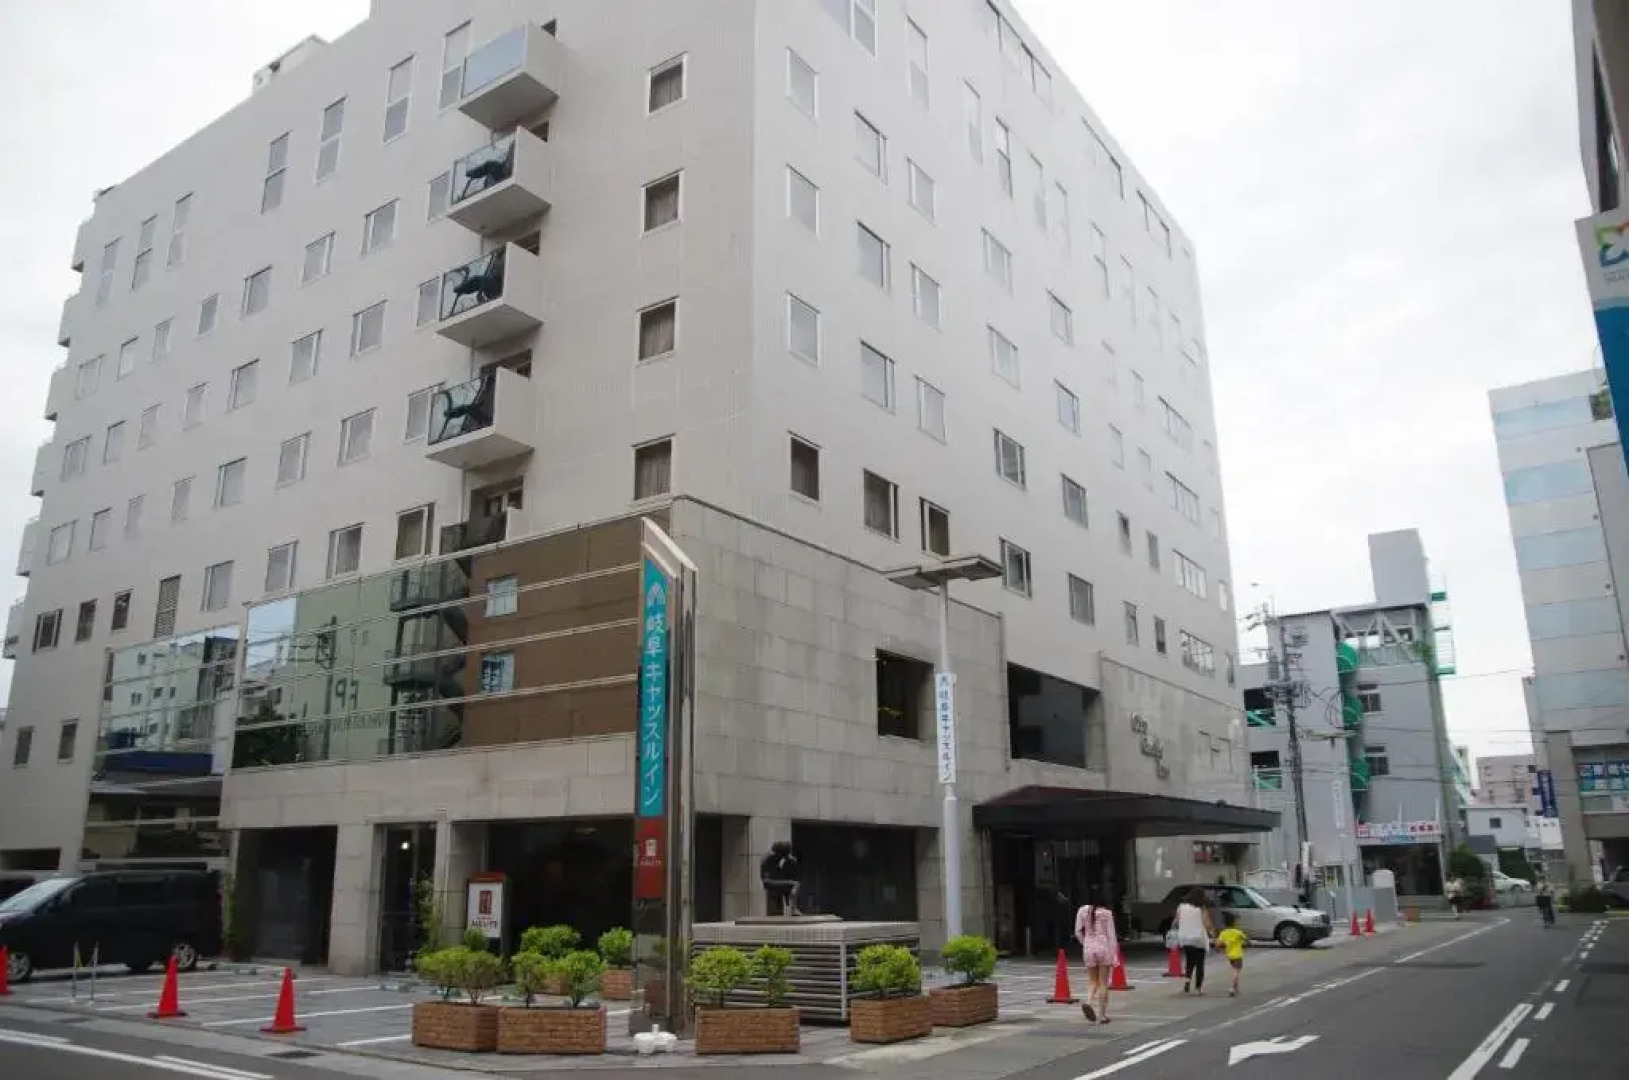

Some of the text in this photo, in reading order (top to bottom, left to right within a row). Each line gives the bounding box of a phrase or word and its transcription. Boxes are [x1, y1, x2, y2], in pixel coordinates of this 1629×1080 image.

[643, 613, 665, 806] 岐阜キャッスルイン
